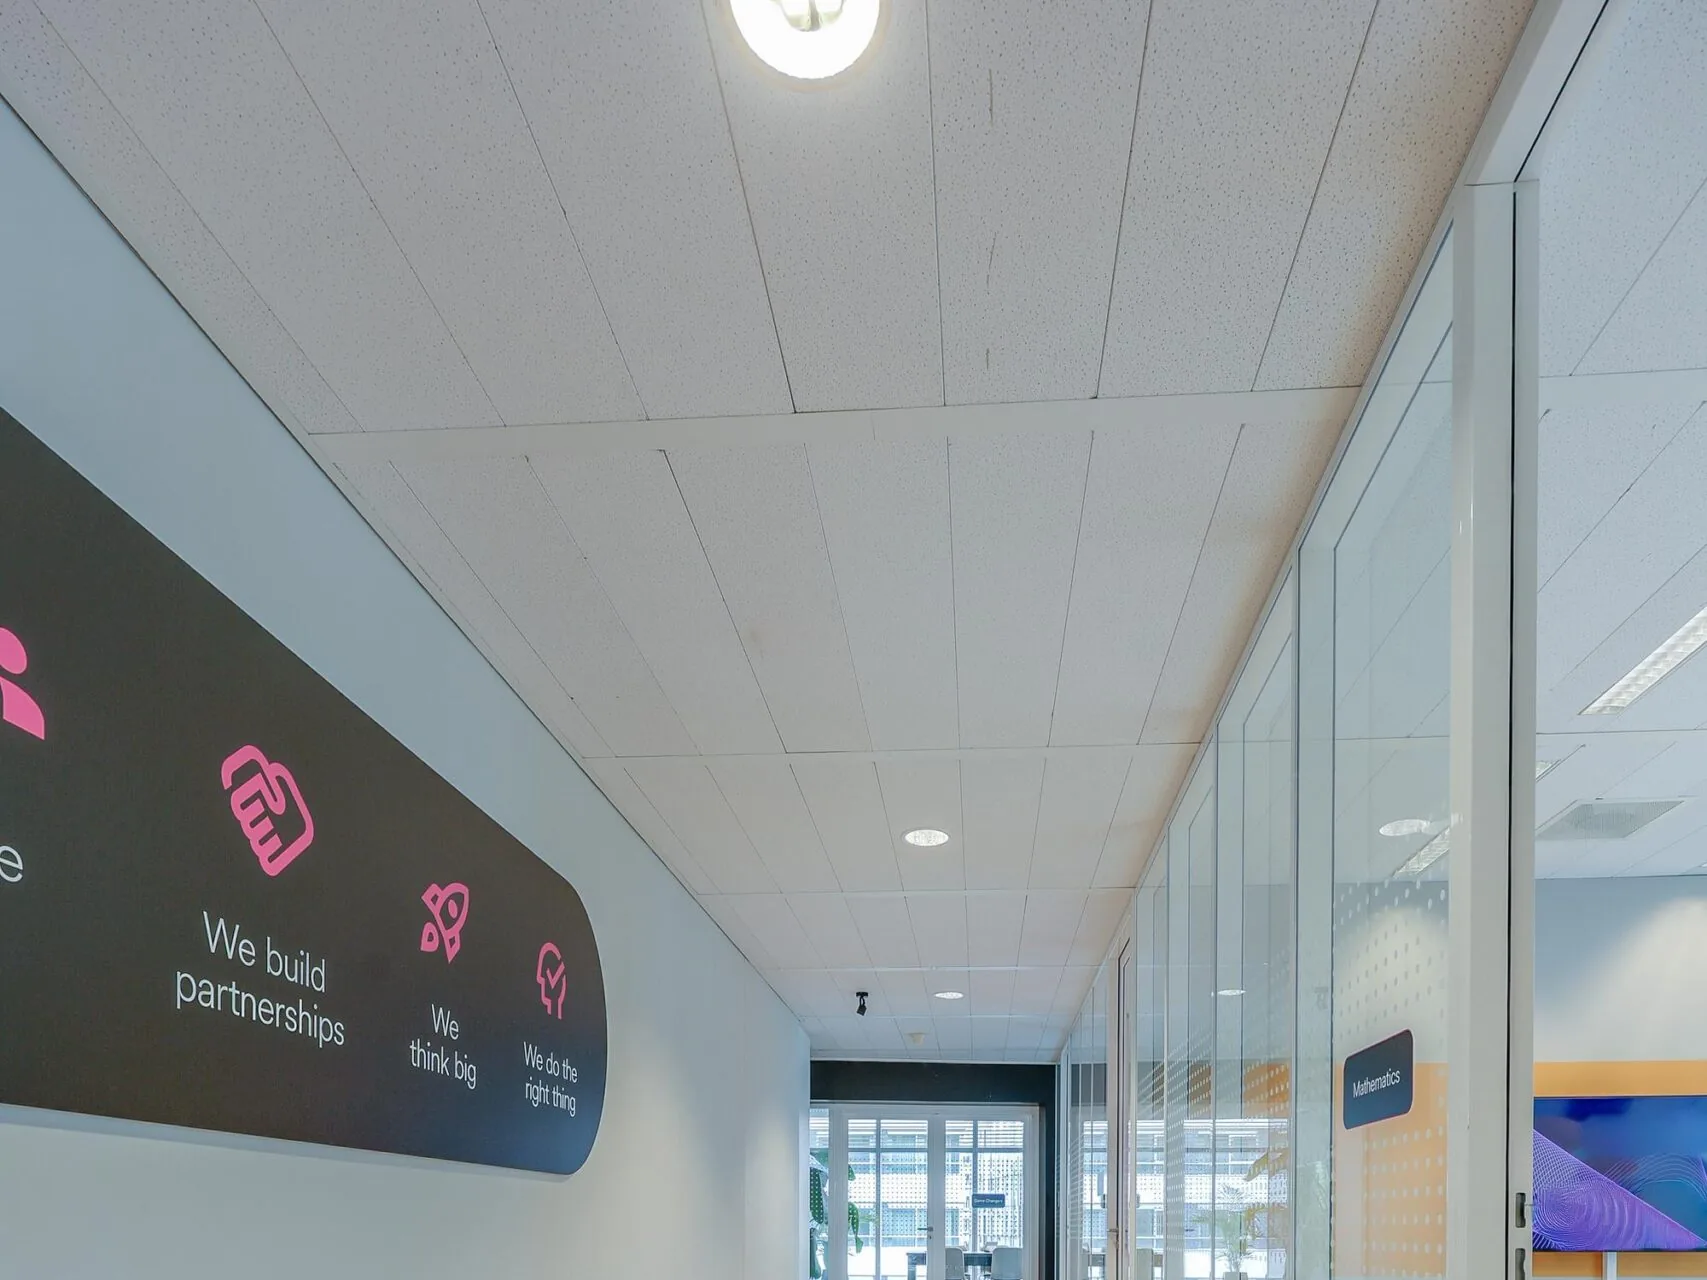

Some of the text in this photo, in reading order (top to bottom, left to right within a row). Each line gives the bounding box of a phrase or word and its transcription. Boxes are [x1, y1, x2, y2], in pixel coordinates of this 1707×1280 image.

[203, 911, 326, 993] We build
[176, 971, 345, 1048] partnerships
[431, 1003, 459, 1040] We
[409, 1038, 477, 1090] think big
[523, 1041, 578, 1083] We do the
[1352, 1067, 1401, 1098] Mathematics
[525, 1076, 576, 1117] right thing
